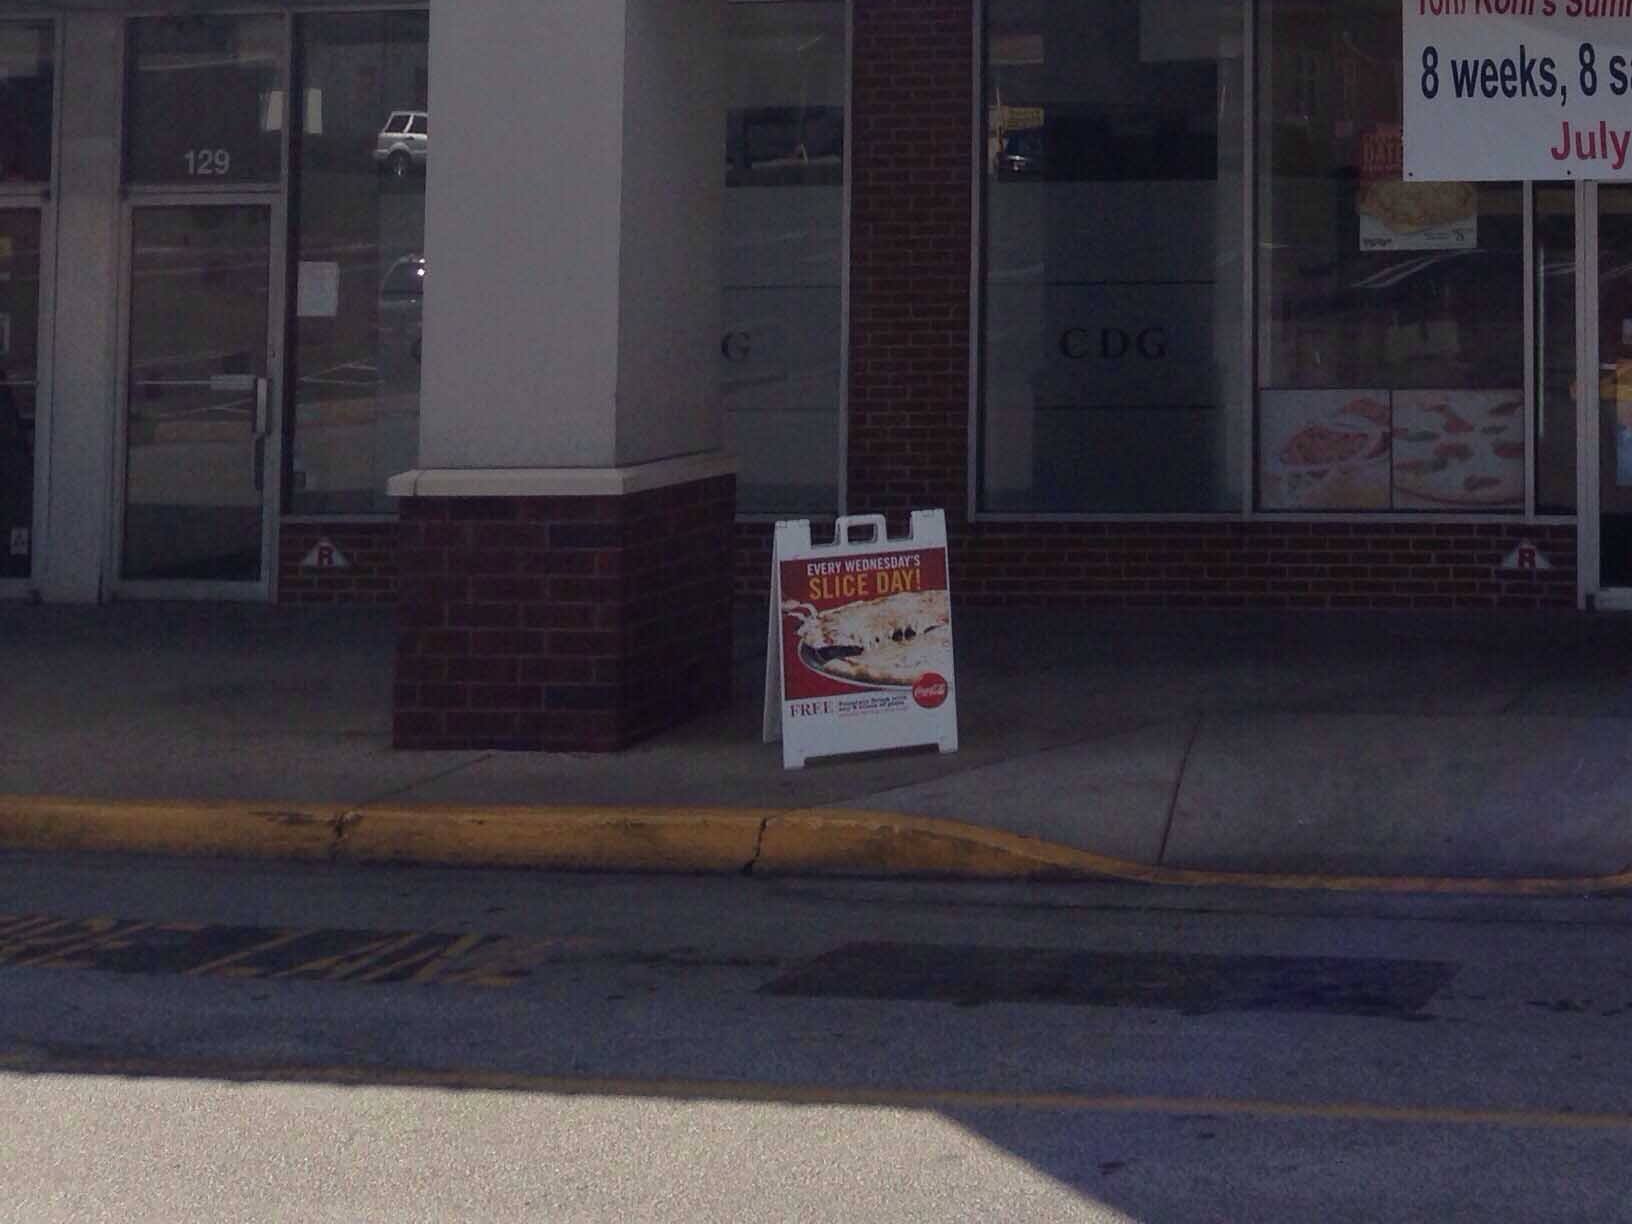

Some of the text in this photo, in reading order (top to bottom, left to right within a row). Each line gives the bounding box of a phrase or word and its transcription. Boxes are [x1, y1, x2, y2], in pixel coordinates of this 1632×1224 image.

[1421, 45, 1439, 99] 8
[1451, 44, 1568, 107] weeks,
[1578, 42, 1596, 98] 8
[1551, 120, 1632, 170] July
[185, 149, 230, 176] 129
[807, 554, 921, 576] EVERY WEDNESDAY'S
[808, 568, 921, 601] SLICE DAY!
